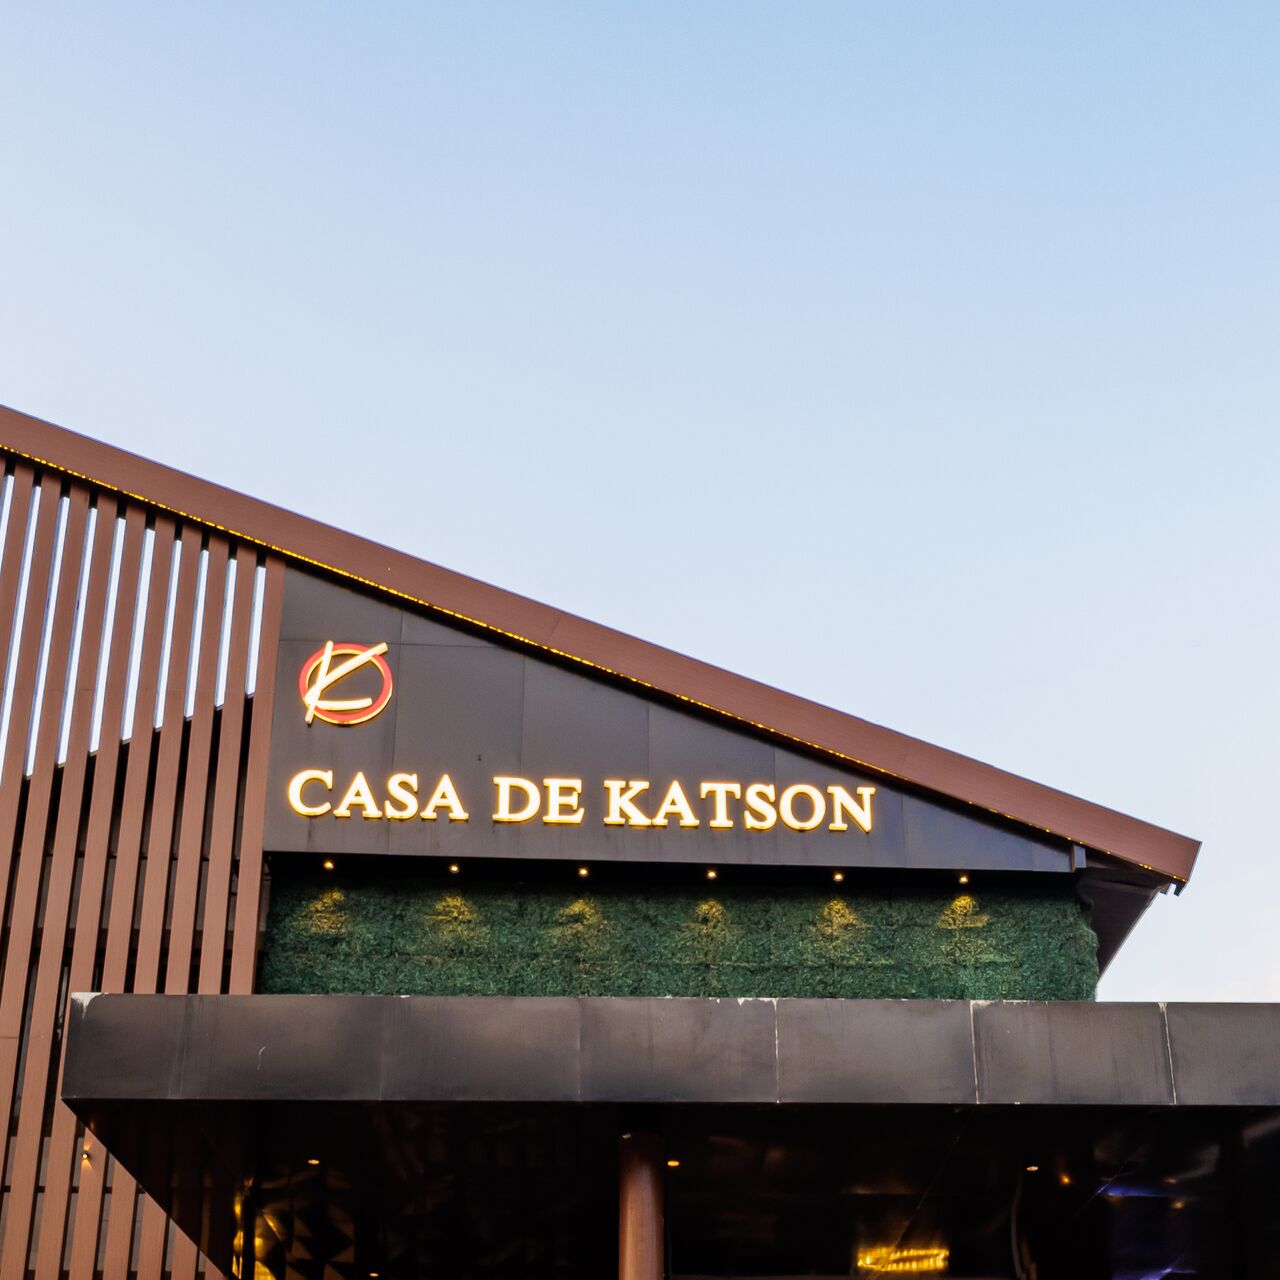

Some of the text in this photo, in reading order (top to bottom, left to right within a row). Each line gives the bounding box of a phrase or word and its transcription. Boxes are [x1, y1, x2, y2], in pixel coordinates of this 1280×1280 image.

[288, 769, 877, 834] CASA DE KATSON
